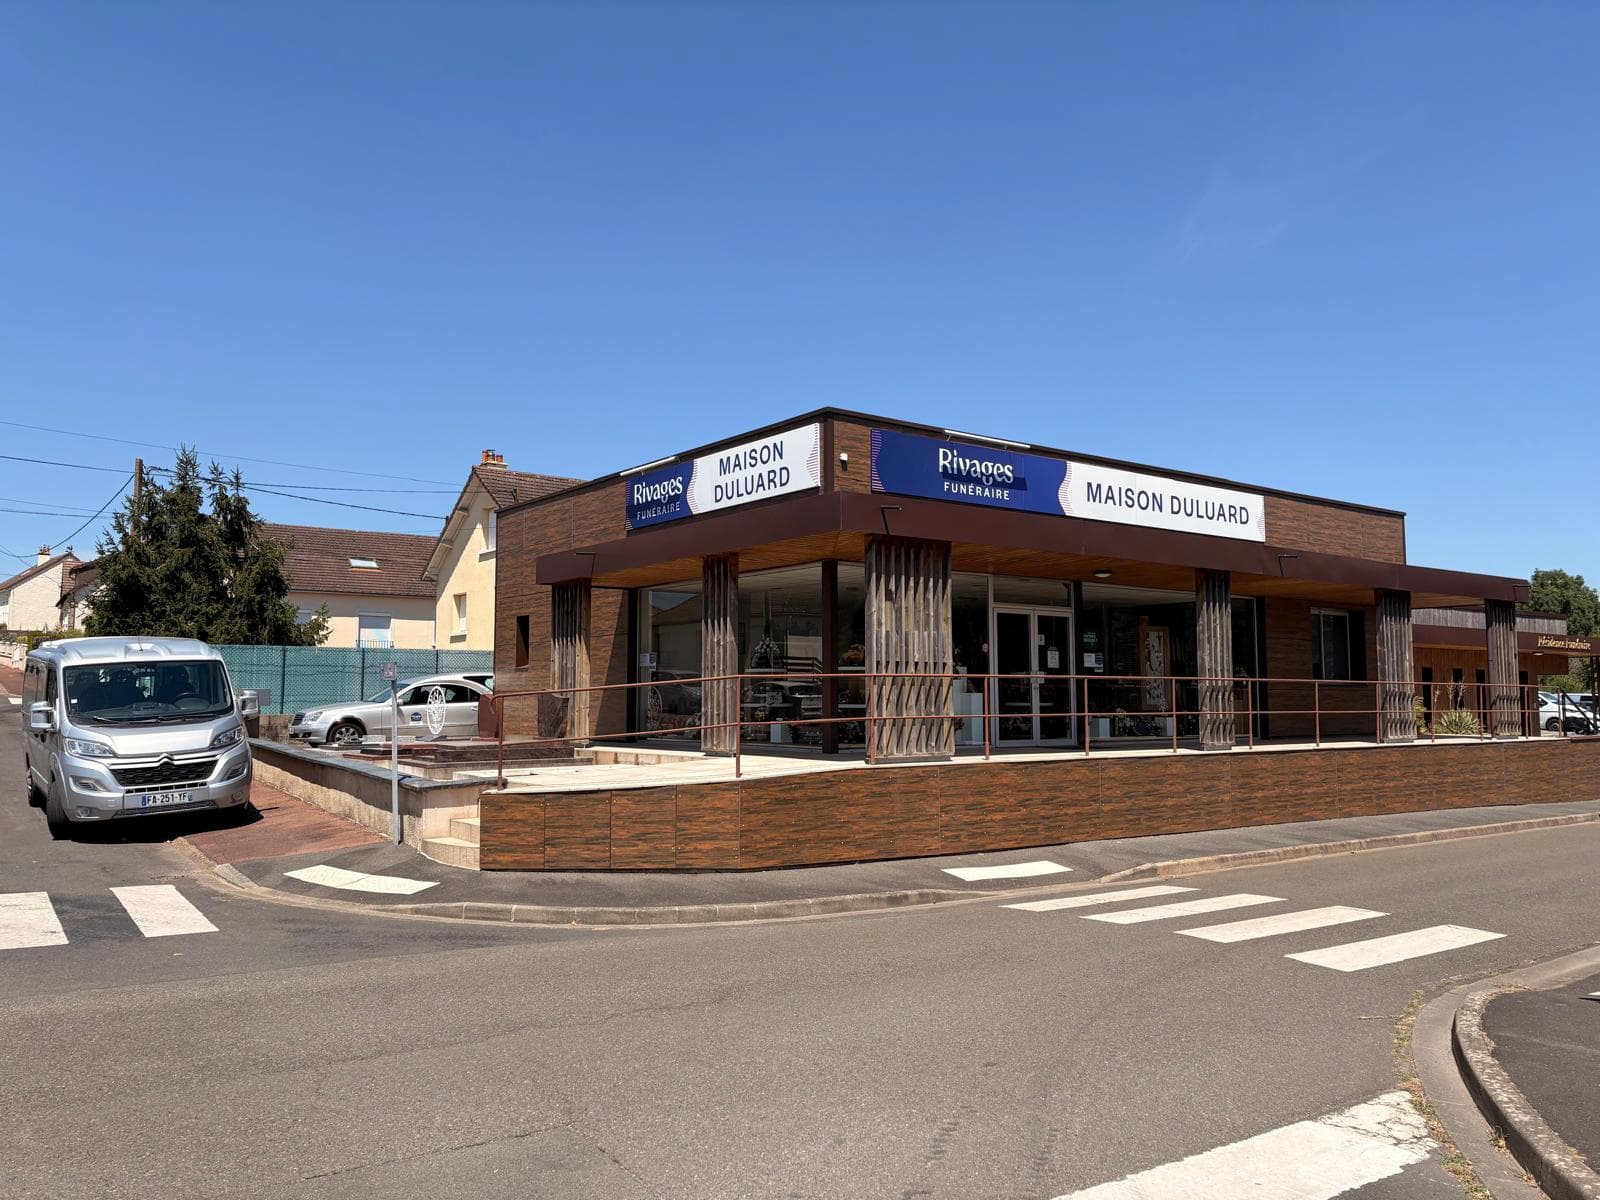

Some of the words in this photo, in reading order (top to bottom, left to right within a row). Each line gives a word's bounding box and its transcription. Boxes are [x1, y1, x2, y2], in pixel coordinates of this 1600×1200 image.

[719, 440, 783, 477] MAISON
[938, 447, 1014, 486] Rivages
[633, 476, 683, 506] Rivages
[714, 466, 790, 504] DULUARD
[943, 481, 1010, 501] FUNÉRAIRE
[1086, 481, 1163, 513] MAISON
[1170, 495, 1250, 525] DULUARD
[636, 501, 681, 520] FUNÉRAIRE
